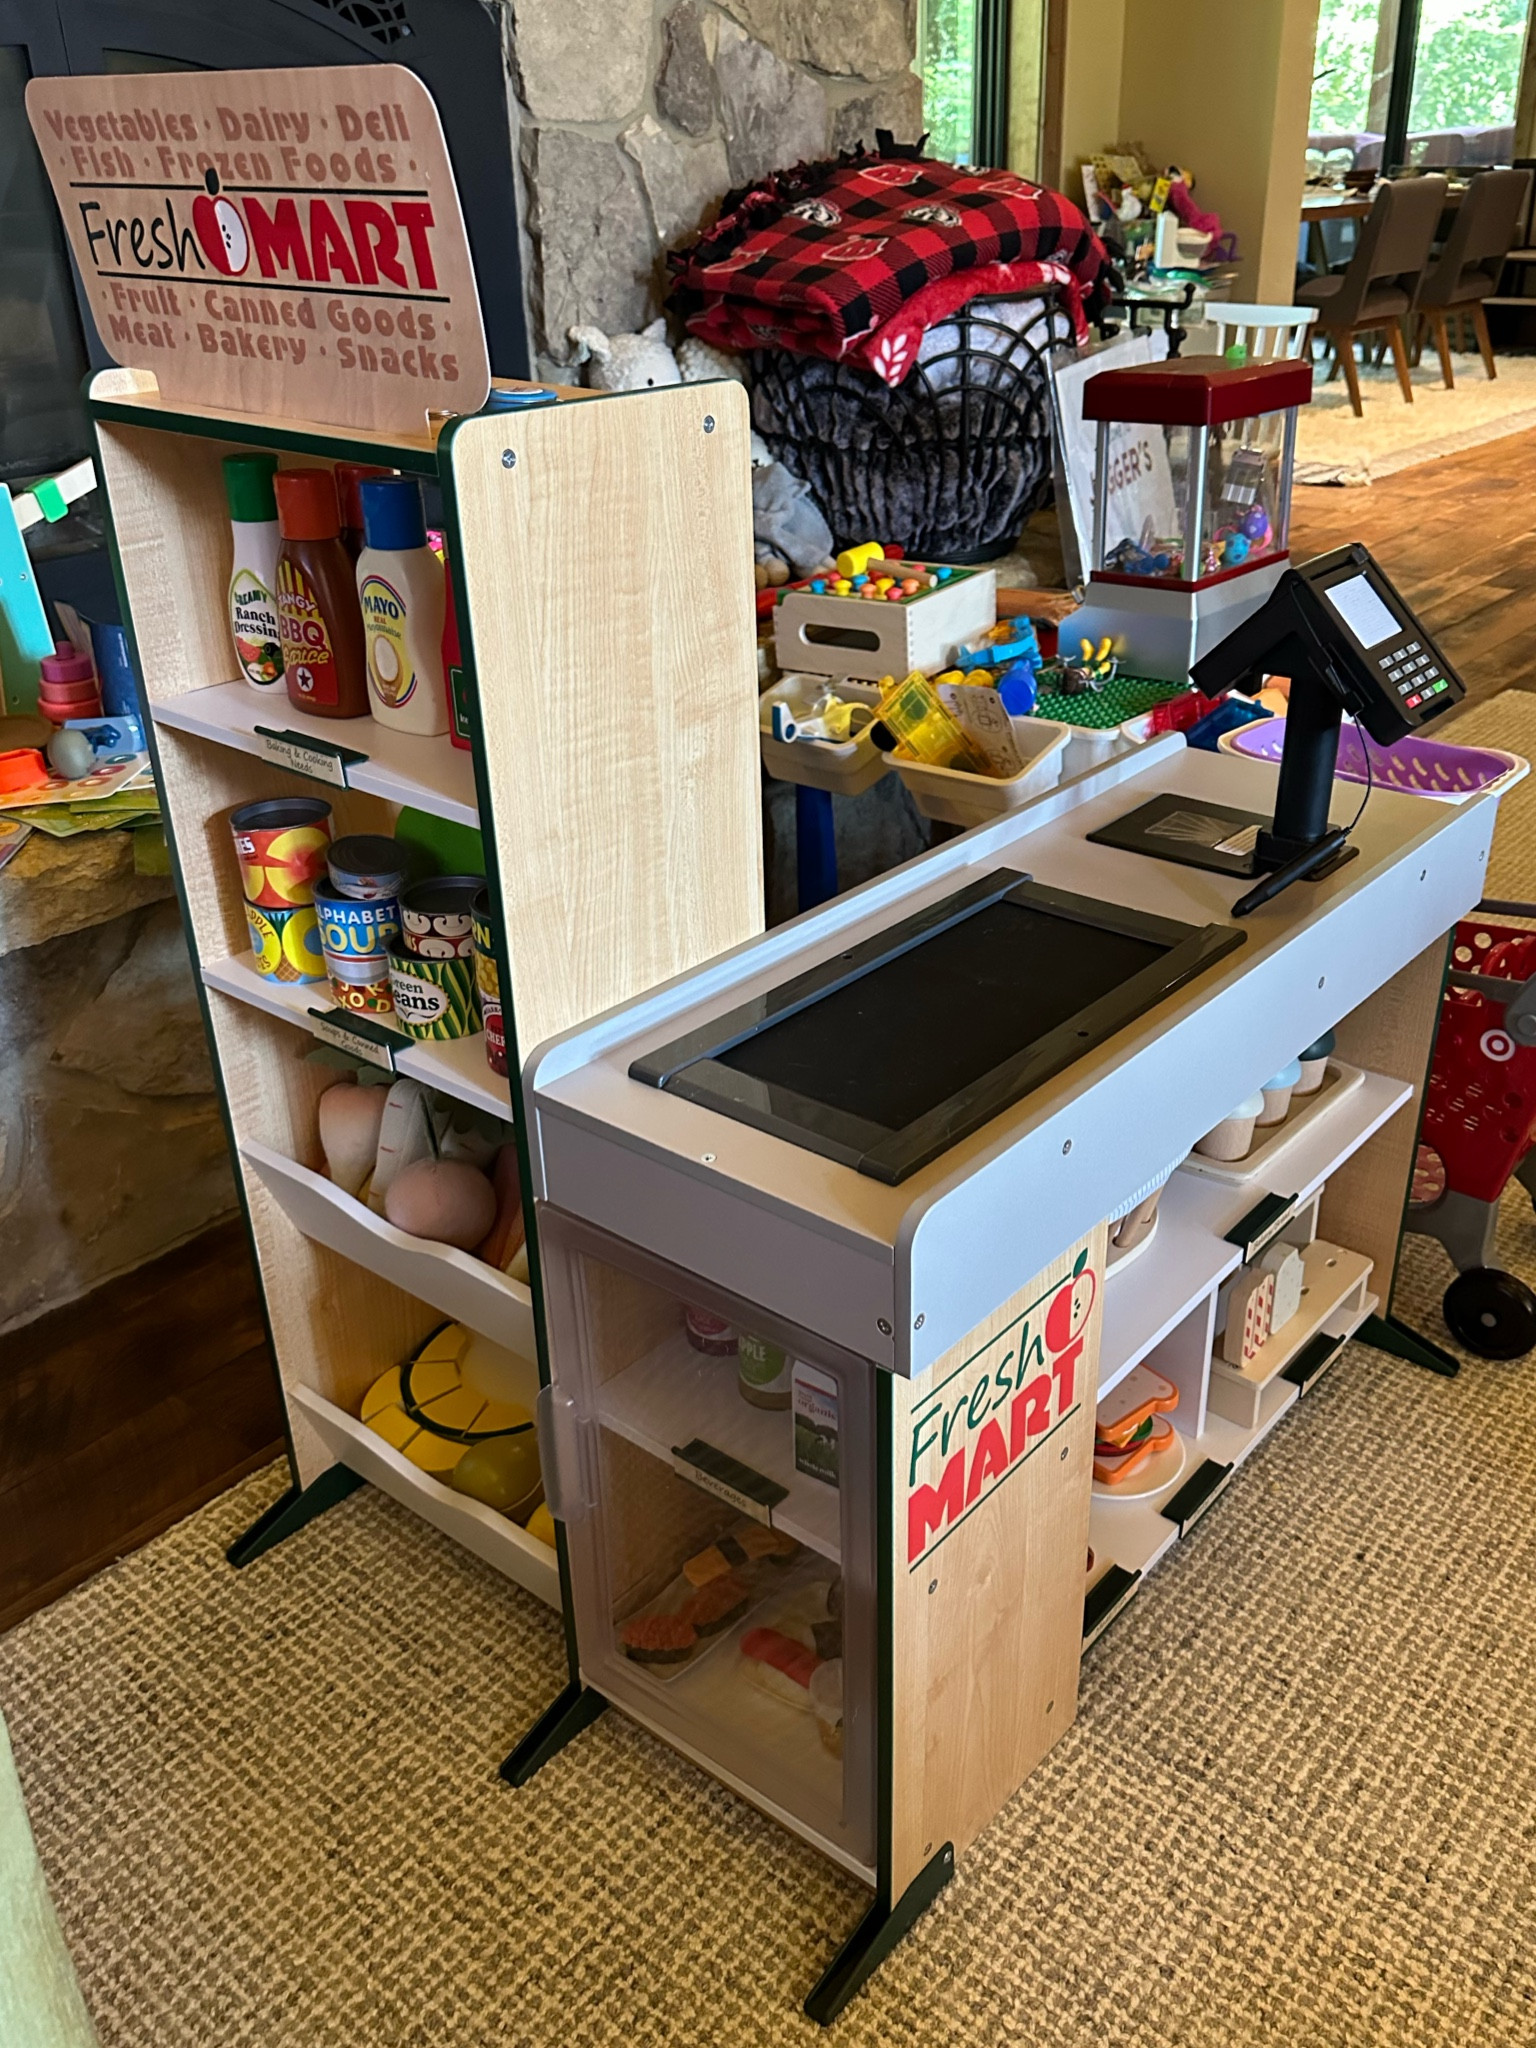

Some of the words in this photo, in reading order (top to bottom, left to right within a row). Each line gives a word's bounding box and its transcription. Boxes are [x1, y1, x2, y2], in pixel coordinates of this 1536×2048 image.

[43, 108, 199, 143] Vegetables
[216, 107, 311, 143] Dairy
[336, 103, 411, 142] Deli
[70, 146, 136, 179] Fish
[156, 146, 272, 182] Frozen
[281, 147, 397, 184] Foods
[79, 198, 206, 273] Fresh
[242, 197, 439, 290] MART
[109, 282, 181, 318] Fruit
[204, 290, 316, 330] Canned
[327, 299, 436, 341] Goods
[107, 314, 177, 350] Meat
[198, 323, 307, 366] Bakery
[337, 337, 460, 382] Snacks
[234, 589, 267, 606] CREAMY
[278, 592, 317, 613] TANGY
[363, 595, 399, 621] MAYO
[235, 606, 276, 626] Ranch
[235, 620, 280, 640] Dressin
[279, 614, 328, 650] BBQ
[265, 739, 292, 758] Baking
[294, 747, 301, 759] &
[303, 751, 334, 773] Cooking
[290, 758, 314, 774] Needs
[908, 1320, 1045, 1487] Fresh
[908, 1336, 1085, 1564] MART
